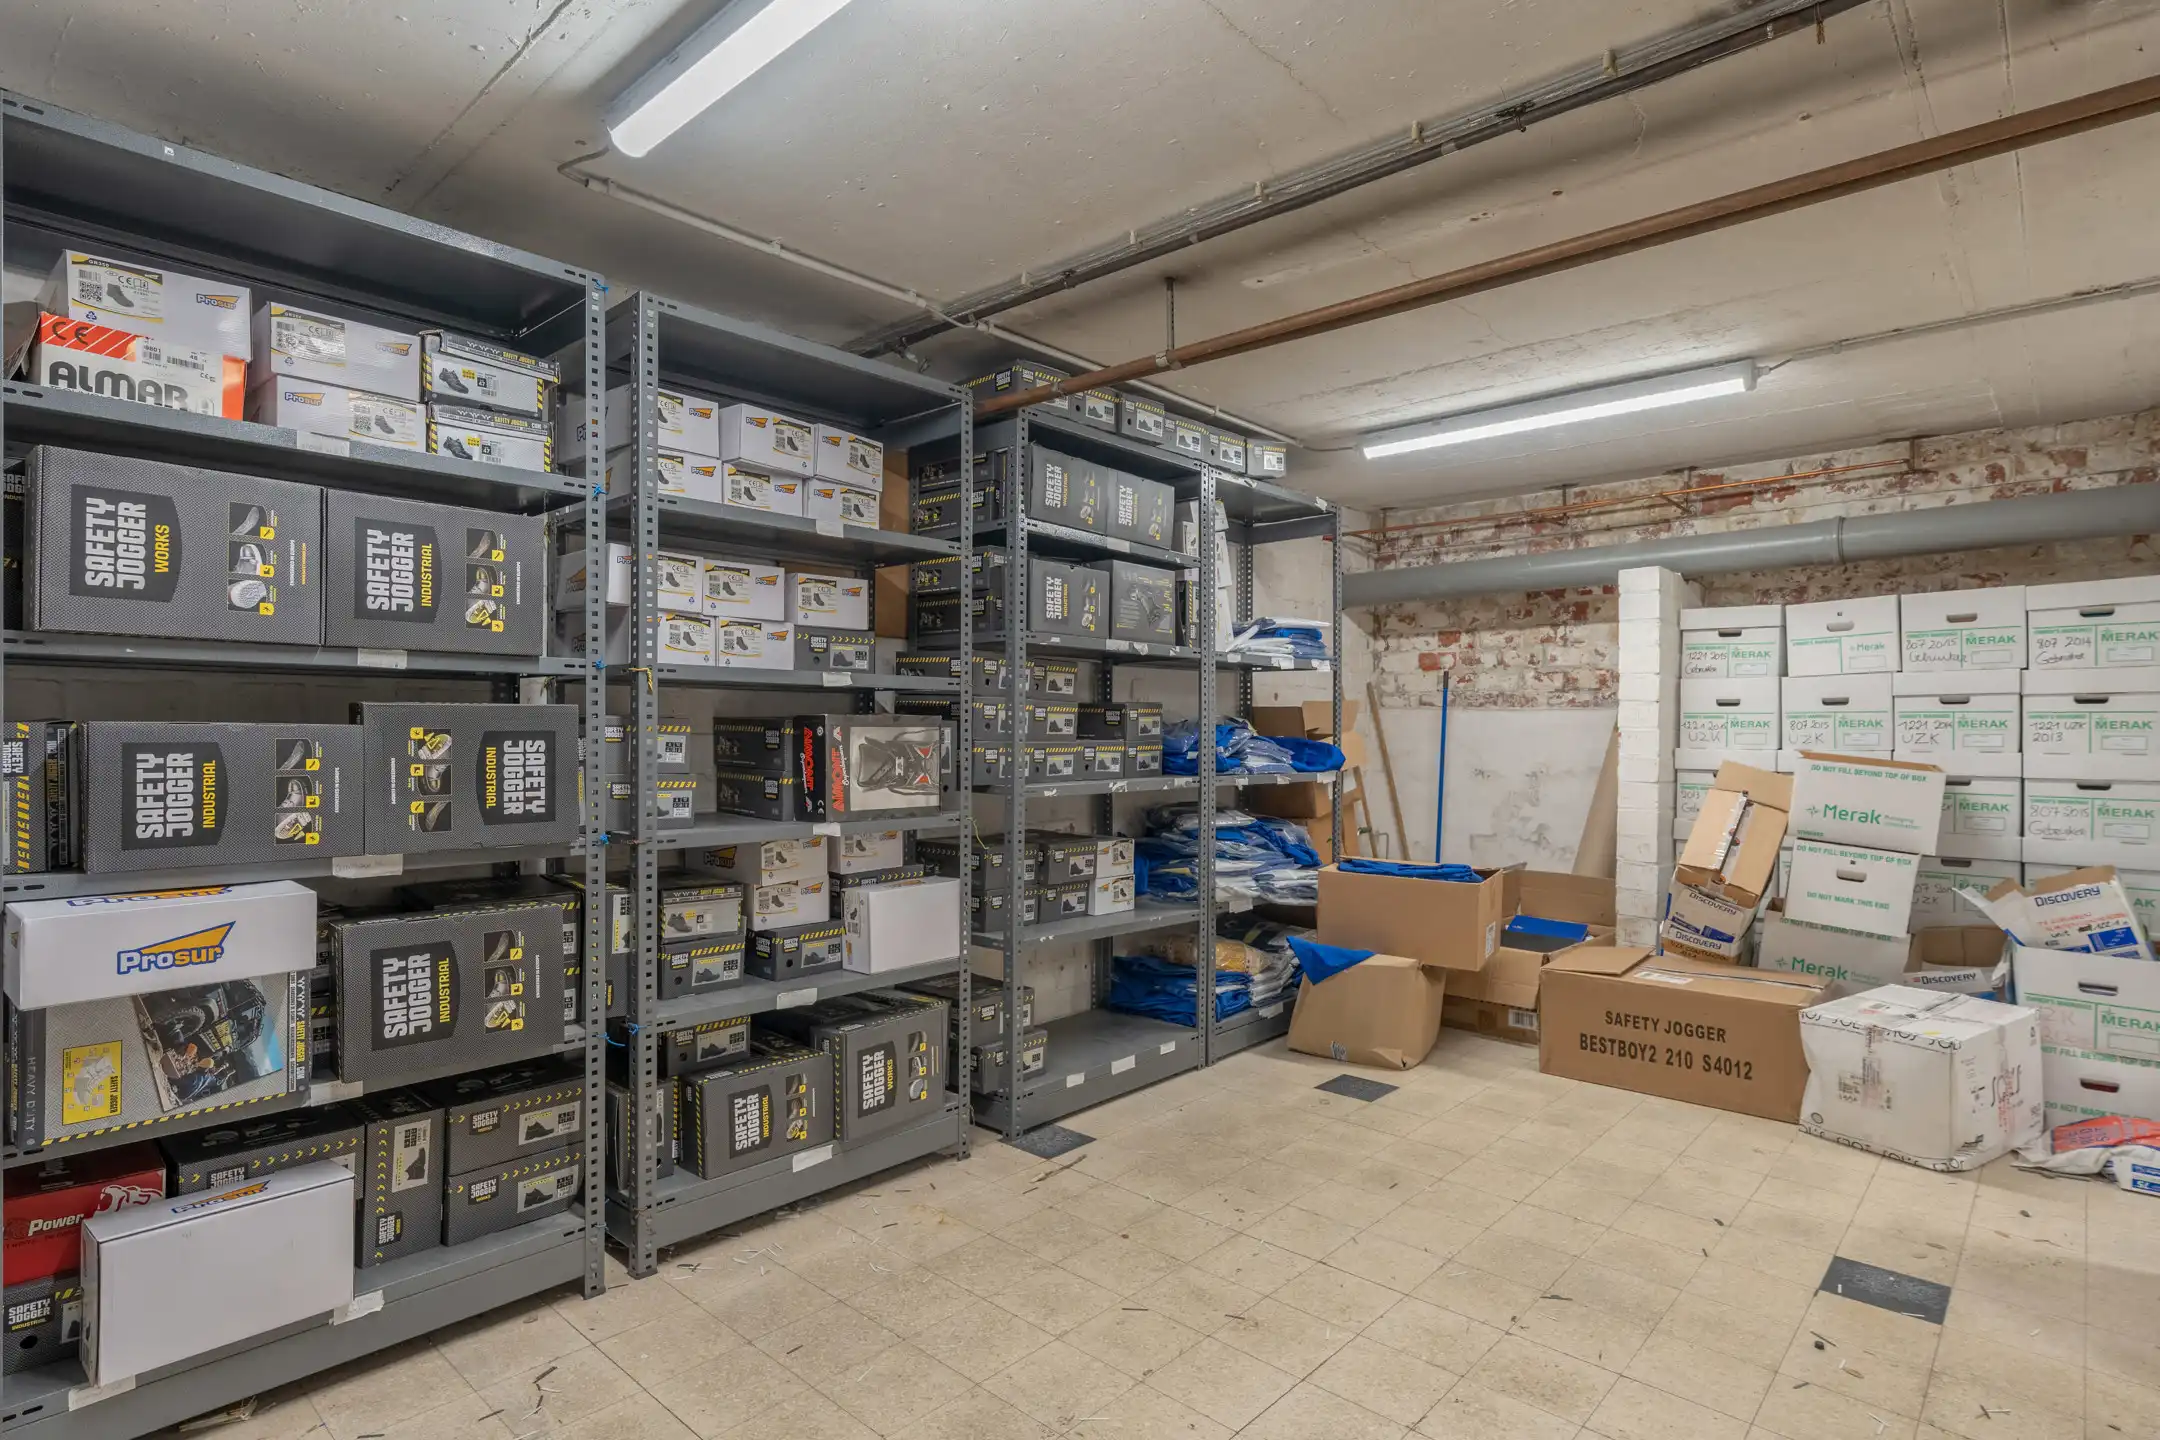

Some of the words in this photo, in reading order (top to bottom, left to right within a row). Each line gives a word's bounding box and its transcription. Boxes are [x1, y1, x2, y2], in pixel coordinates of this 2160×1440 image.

[49, 361, 189, 411] ALMAR
[1045, 463, 1054, 508] SAFETY
[1053, 466, 1062, 508] JOGGER
[1119, 485, 1127, 527] SAFETY
[1126, 487, 1134, 526] JOGGER
[84, 497, 116, 588] SAFETY
[116, 501, 147, 590] JOGGER
[154, 524, 170, 573] WORKS
[366, 528, 390, 611] SAFETY
[390, 532, 414, 613] JOGGER
[420, 543, 432, 607] INDUSTRIAL
[1046, 576, 1055, 619] SAFETY
[1054, 577, 1063, 620] JOGGER
[1858, 642, 1885, 651] Merak
[1965, 635, 2016, 646] MERAK
[2101, 631, 2158, 642] MERAK
[1731, 650, 1771, 659] MERAK
[1729, 720, 1770, 729] MERAK
[1838, 719, 1883, 728] MERAK
[1957, 719, 2008, 729] MERAK
[2032, 732, 2063, 743] 2013
[2095, 720, 2152, 730] MERAK
[1788, 732, 1824, 744] UZK
[1901, 732, 1940, 745] UZK
[3, 741, 12, 774] JOGGER
[12, 741, 23, 773] SAFETY
[485, 747, 497, 809] INDUSTRIAL
[503, 740, 524, 815] JOGGER
[524, 739, 546, 814] SAFETY
[1822, 765, 1836, 773] NOT
[1837, 767, 1852, 775] FILL
[1853, 768, 1882, 778] BEYOND
[1884, 771, 1898, 779] TOP
[1911, 774, 1927, 782] BOX
[136, 753, 165, 839] SAFETY
[165, 752, 194, 838] JOGGER
[202, 759, 216, 829] INDUSTRIAL
[1959, 802, 2010, 812] MERAK
[1823, 803, 1882, 825] Merak
[2097, 807, 2156, 819] MERAK
[703, 851, 735, 868] Prosur
[1839, 848, 1868, 860] BEYOND
[1870, 854, 1883, 862] TOP
[67, 886, 233, 907] Prosur
[1689, 891, 1737, 915] DISCOVERY
[1818, 892, 1833, 901] NOT
[1834, 896, 1855, 904] MARK
[1857, 898, 1873, 908] THIS
[2034, 886, 2101, 908] DISCOVERY
[1675, 931, 1722, 950] DISCOVERY
[117, 945, 225, 975] Prosur
[1791, 956, 1848, 979] Merak
[439, 957, 451, 1023] INDUSTRIAL
[1920, 972, 1977, 985] DISCOVERY
[382, 957, 407, 1039] SAFETY
[407, 952, 432, 1035] JOGGER
[1605, 1010, 1660, 1033] SAFETY
[1664, 1020, 1727, 1043] JOGGER
[1580, 1032, 1657, 1063] BESTBOY2
[1666, 1048, 1693, 1069] 210
[1702, 1054, 1753, 1080] S4012
[26, 1056, 37, 1095] HEAVY
[862, 1054, 874, 1110] SAFETY
[874, 1050, 885, 1104] JOGGER
[472, 1111, 498, 1123] SAFETY
[472, 1117, 498, 1129] JOGGER
[735, 1097, 747, 1150] SAFETY
[747, 1092, 760, 1146] JOGGER
[210, 1167, 245, 1183] SAFETY
[470, 1180, 497, 1192] SAFETY
[470, 1186, 497, 1199] JOGGER
[28, 1214, 84, 1236] Power
[378, 1217, 387, 1245] SAFETY
[387, 1214, 395, 1242] JOGGER
[8, 1299, 50, 1315] SAFETY
[8, 1309, 50, 1326] JOGGER
